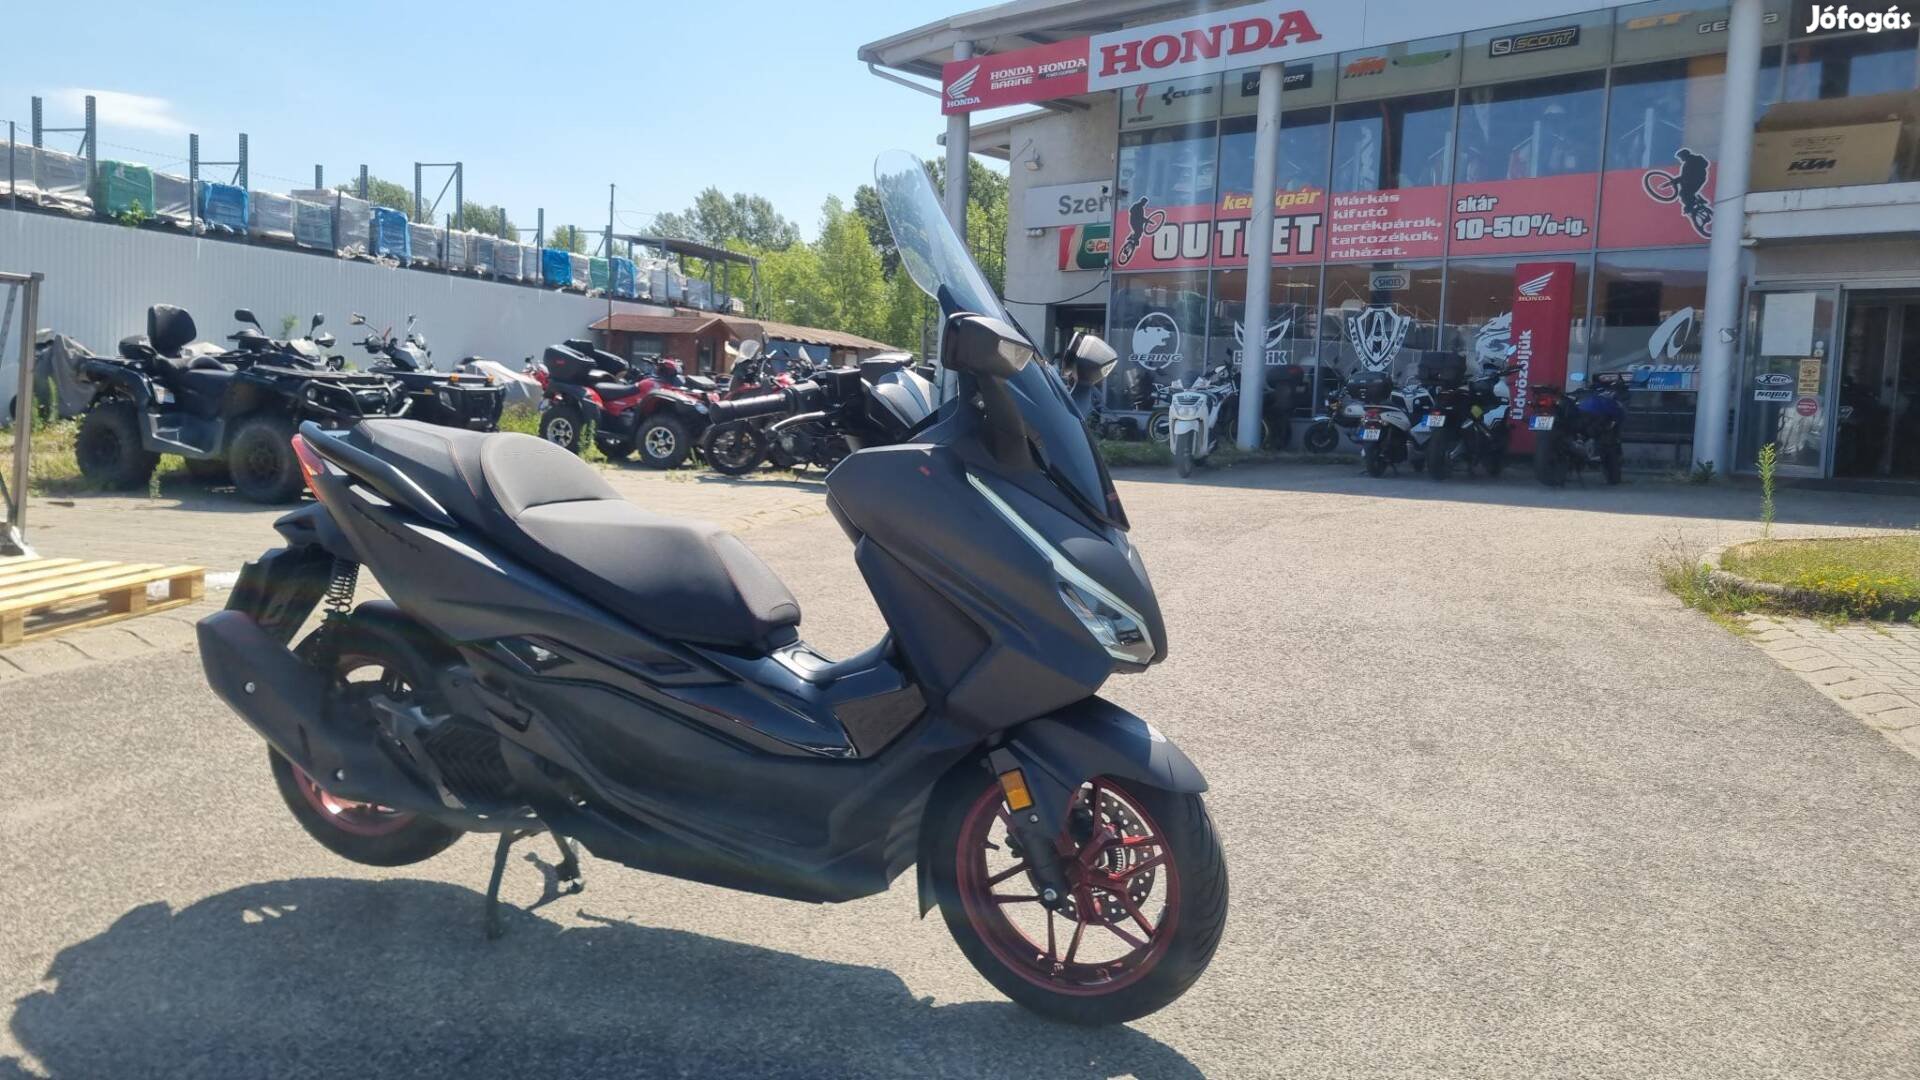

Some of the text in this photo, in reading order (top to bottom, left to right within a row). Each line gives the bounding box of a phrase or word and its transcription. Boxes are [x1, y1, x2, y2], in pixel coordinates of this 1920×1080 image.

[1099, 9, 1322, 77] HONDA
[990, 65, 1034, 80] HONDA
[1038, 58, 1087, 75] HONDA
[946, 96, 981, 108] HONDA
[1334, 193, 1400, 206] Márkás
[1457, 195, 1498, 213] akár
[1333, 206, 1388, 219] kifutó
[1332, 217, 1442, 233] kerékpárok,
[1455, 214, 1589, 240] 10-50%-ig.
[1331, 246, 1407, 258] ruházat.
[1129, 353, 1184, 362] BERING
